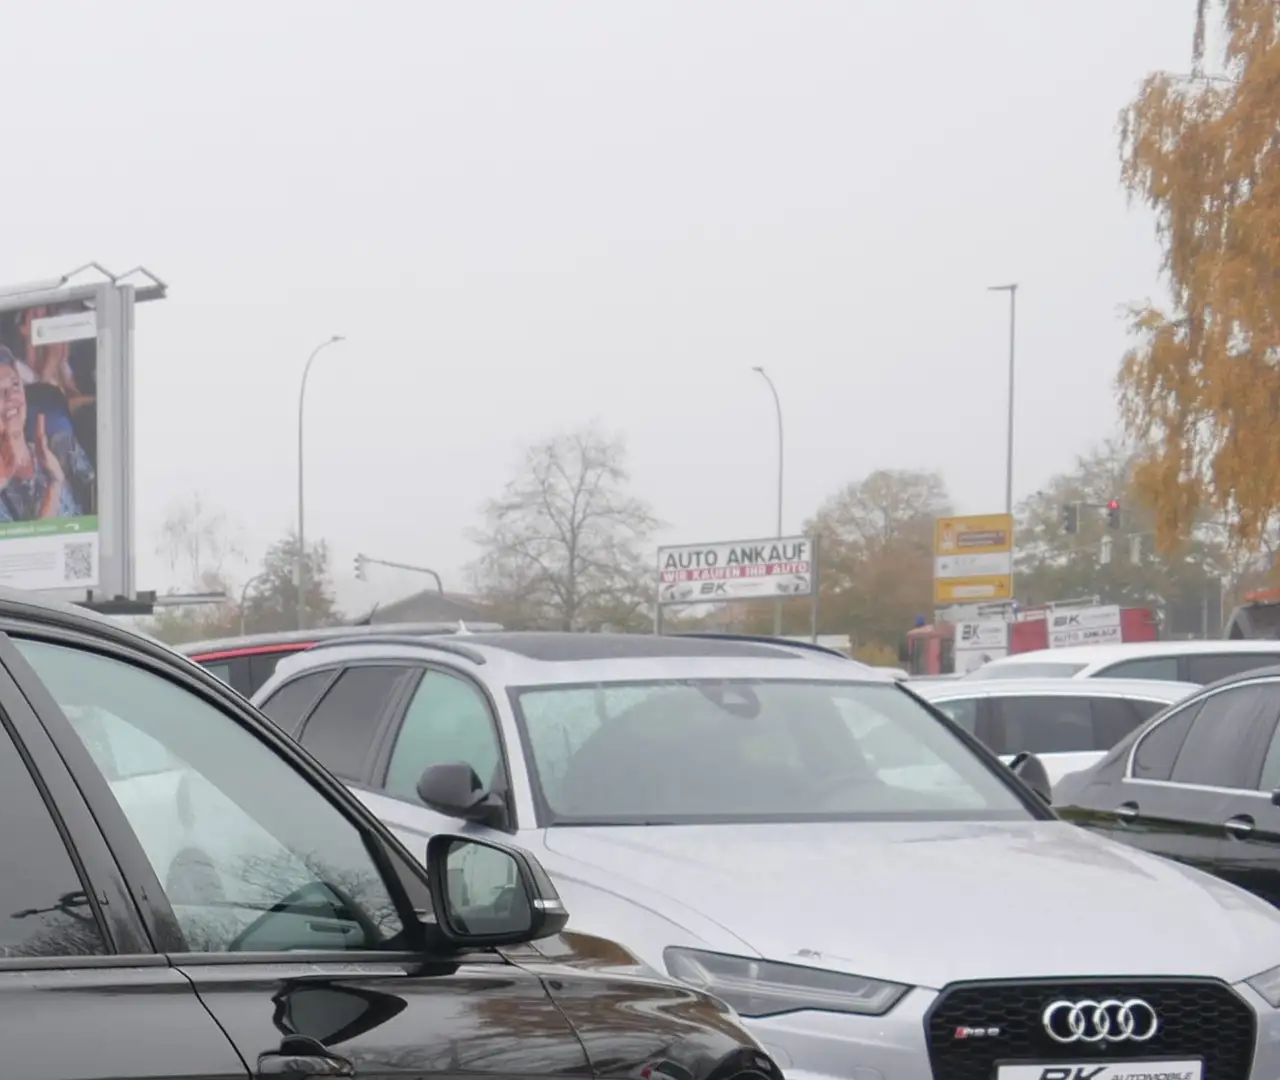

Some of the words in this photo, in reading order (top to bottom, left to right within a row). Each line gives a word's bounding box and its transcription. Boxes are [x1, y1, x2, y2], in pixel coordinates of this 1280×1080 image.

[665, 550, 718, 569] AUTO
[727, 542, 807, 565] ANKAUF
[663, 570, 689, 582] WIR
[692, 565, 741, 581] KAUFEN
[745, 564, 767, 577] IHR
[772, 562, 808, 575] AUTO
[700, 582, 728, 595] BK
